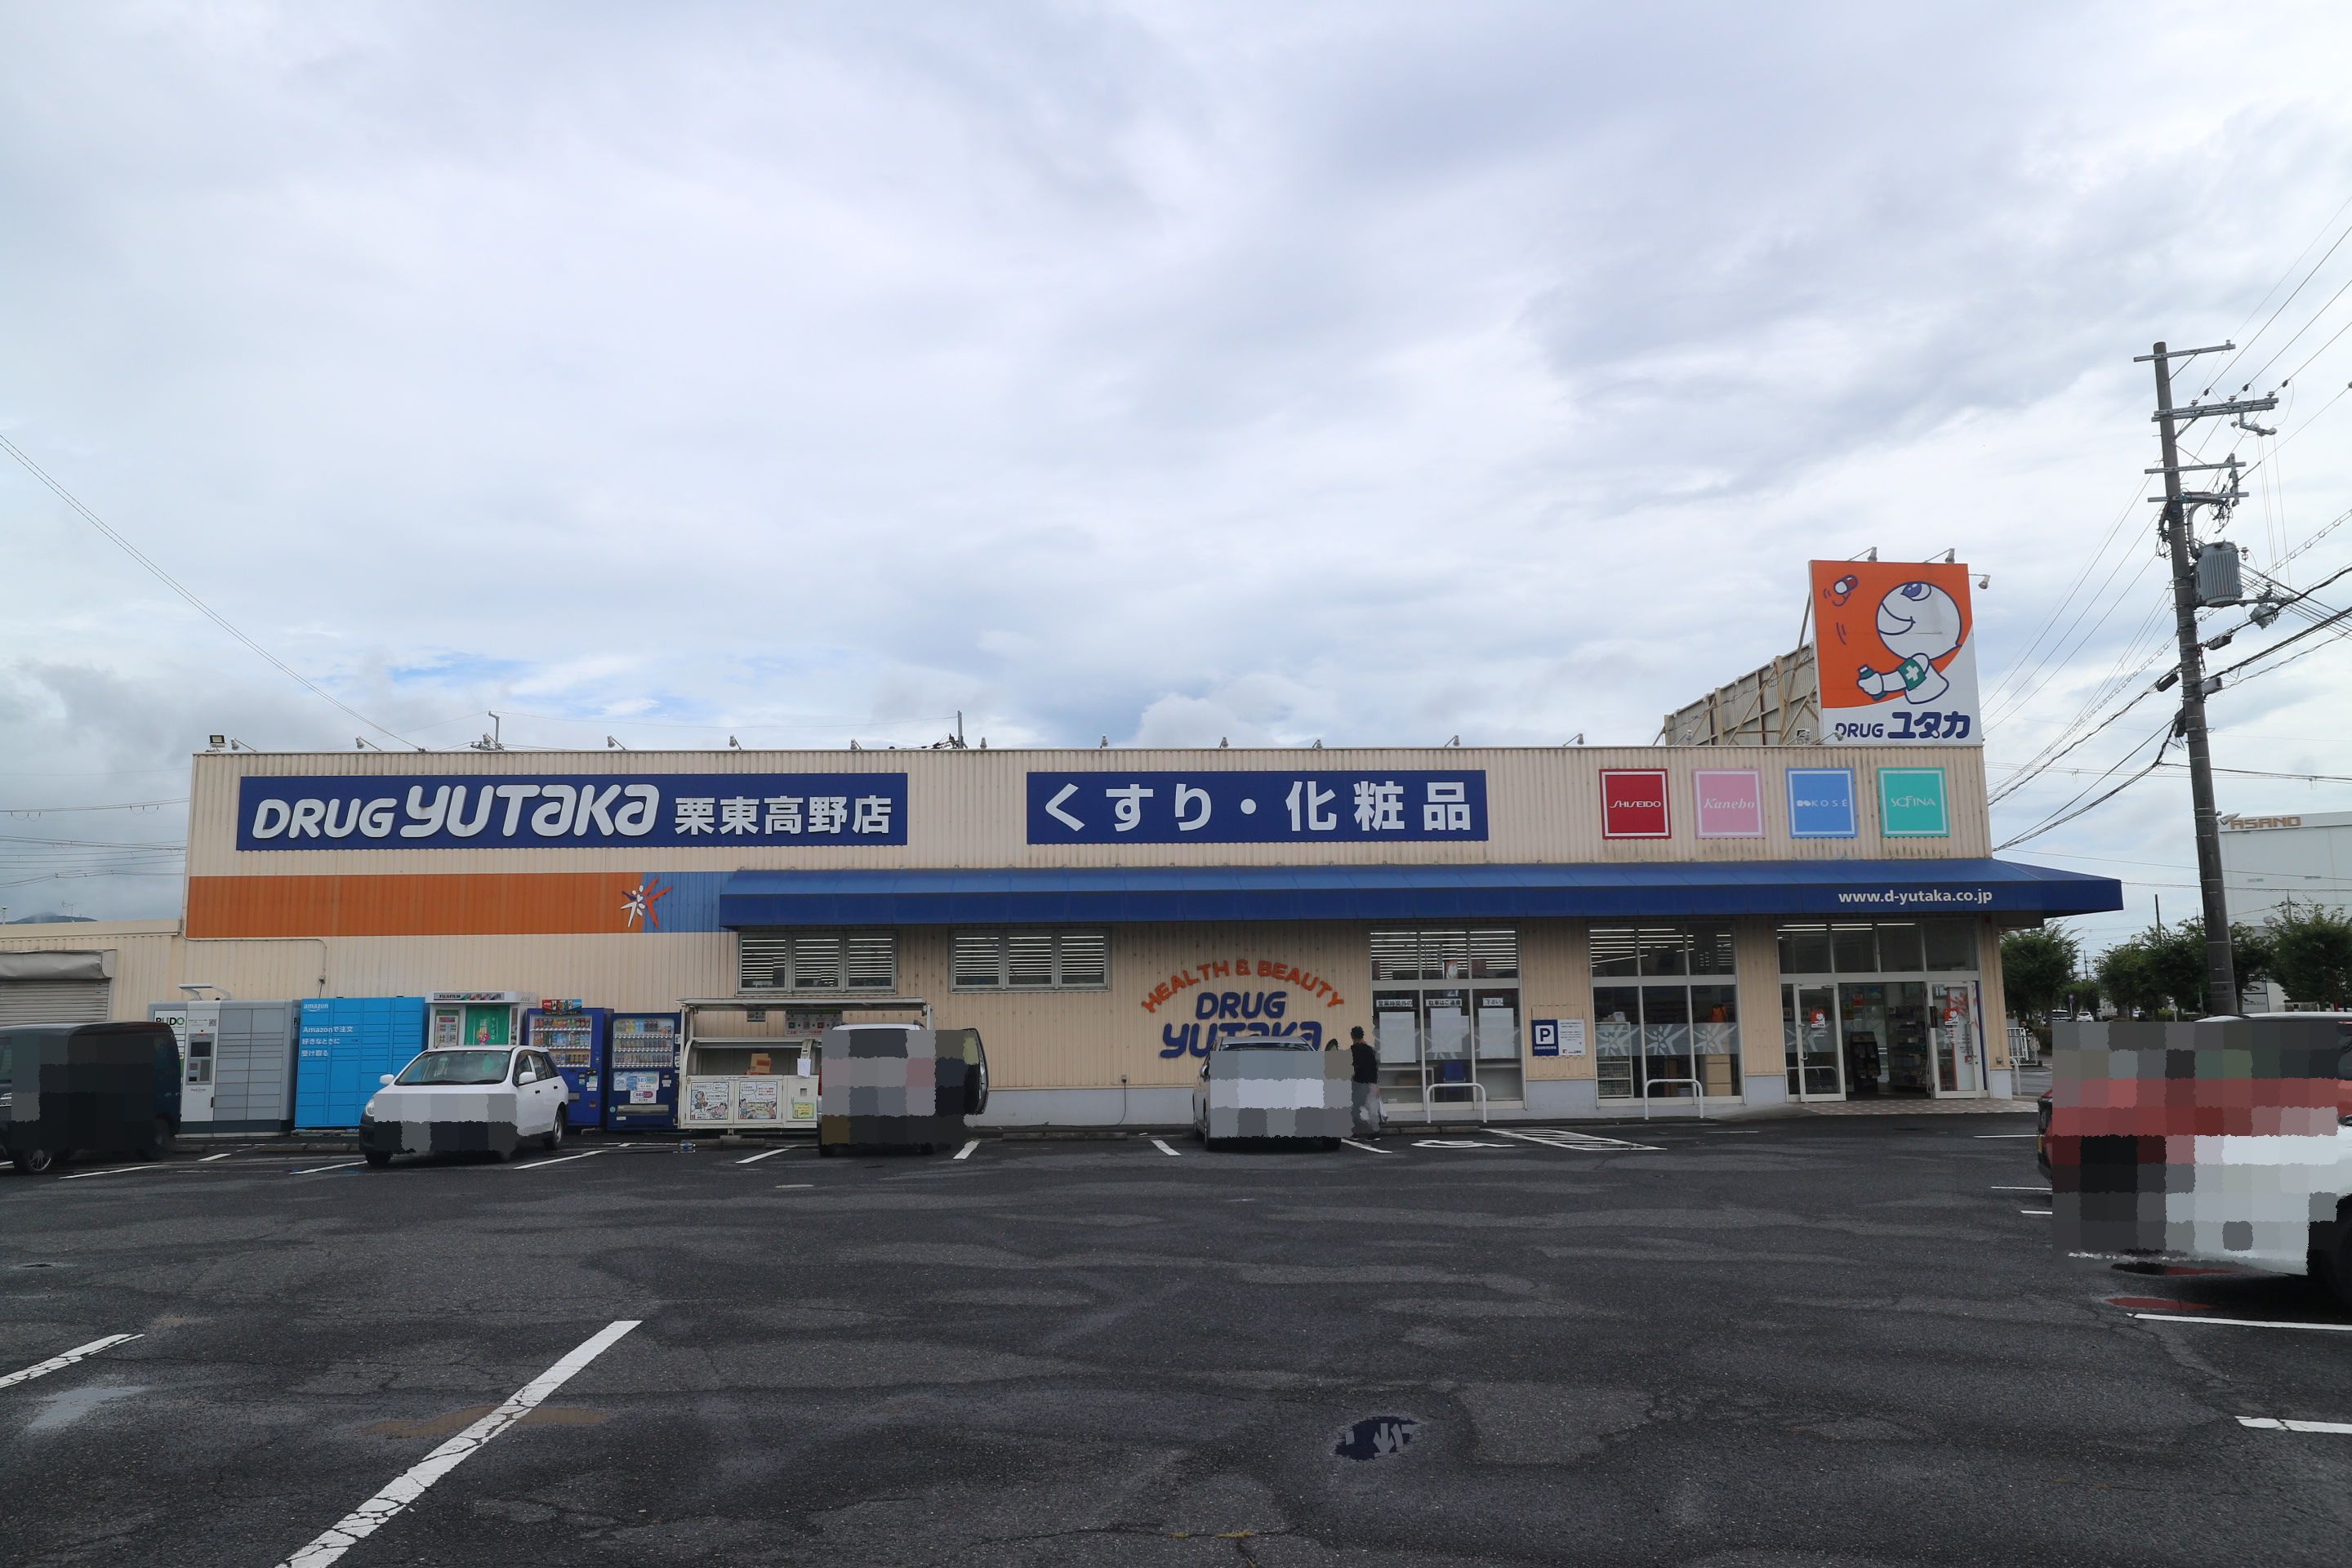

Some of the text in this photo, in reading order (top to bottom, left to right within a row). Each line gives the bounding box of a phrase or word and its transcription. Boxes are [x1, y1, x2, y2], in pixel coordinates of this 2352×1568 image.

[1835, 711, 1971, 739] DRUG ユタカ
[1045, 781, 1471, 831] くすり・化粧品
[1610, 800, 1661, 808] SHISEIDO
[1704, 798, 1755, 808] Kanebo
[1891, 796, 1936, 808] SOFINA
[252, 798, 398, 839] DRUG
[675, 795, 892, 835] 栗東高野店
[2230, 817, 2301, 830] ASANO
[1838, 889, 1993, 905] www.d-yutaka.co.jp
[1142, 959, 1345, 1013] HEALTH & BEAUTY
[1196, 991, 1287, 1020] DRUG
[1539, 1027, 1551, 1042] P
